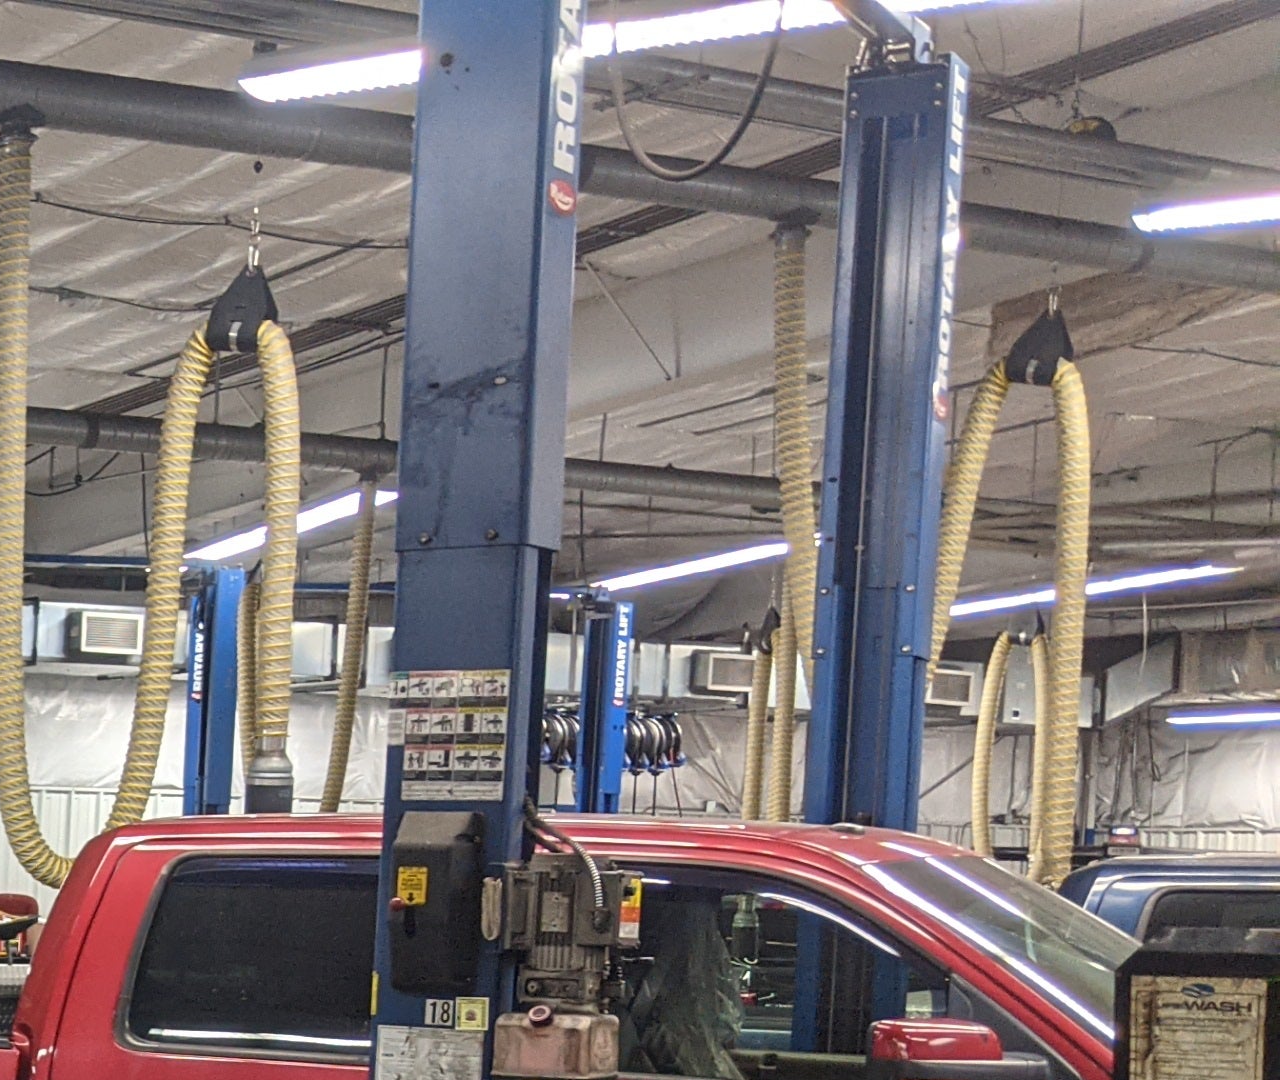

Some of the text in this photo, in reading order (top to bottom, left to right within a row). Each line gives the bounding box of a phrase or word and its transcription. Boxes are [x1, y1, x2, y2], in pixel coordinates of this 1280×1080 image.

[949, 65, 965, 174] LIFT
[614, 604, 629, 698] ROTARY LIFT
[430, 1001, 451, 1024] 18
[1158, 1000, 1254, 1014] WASH
